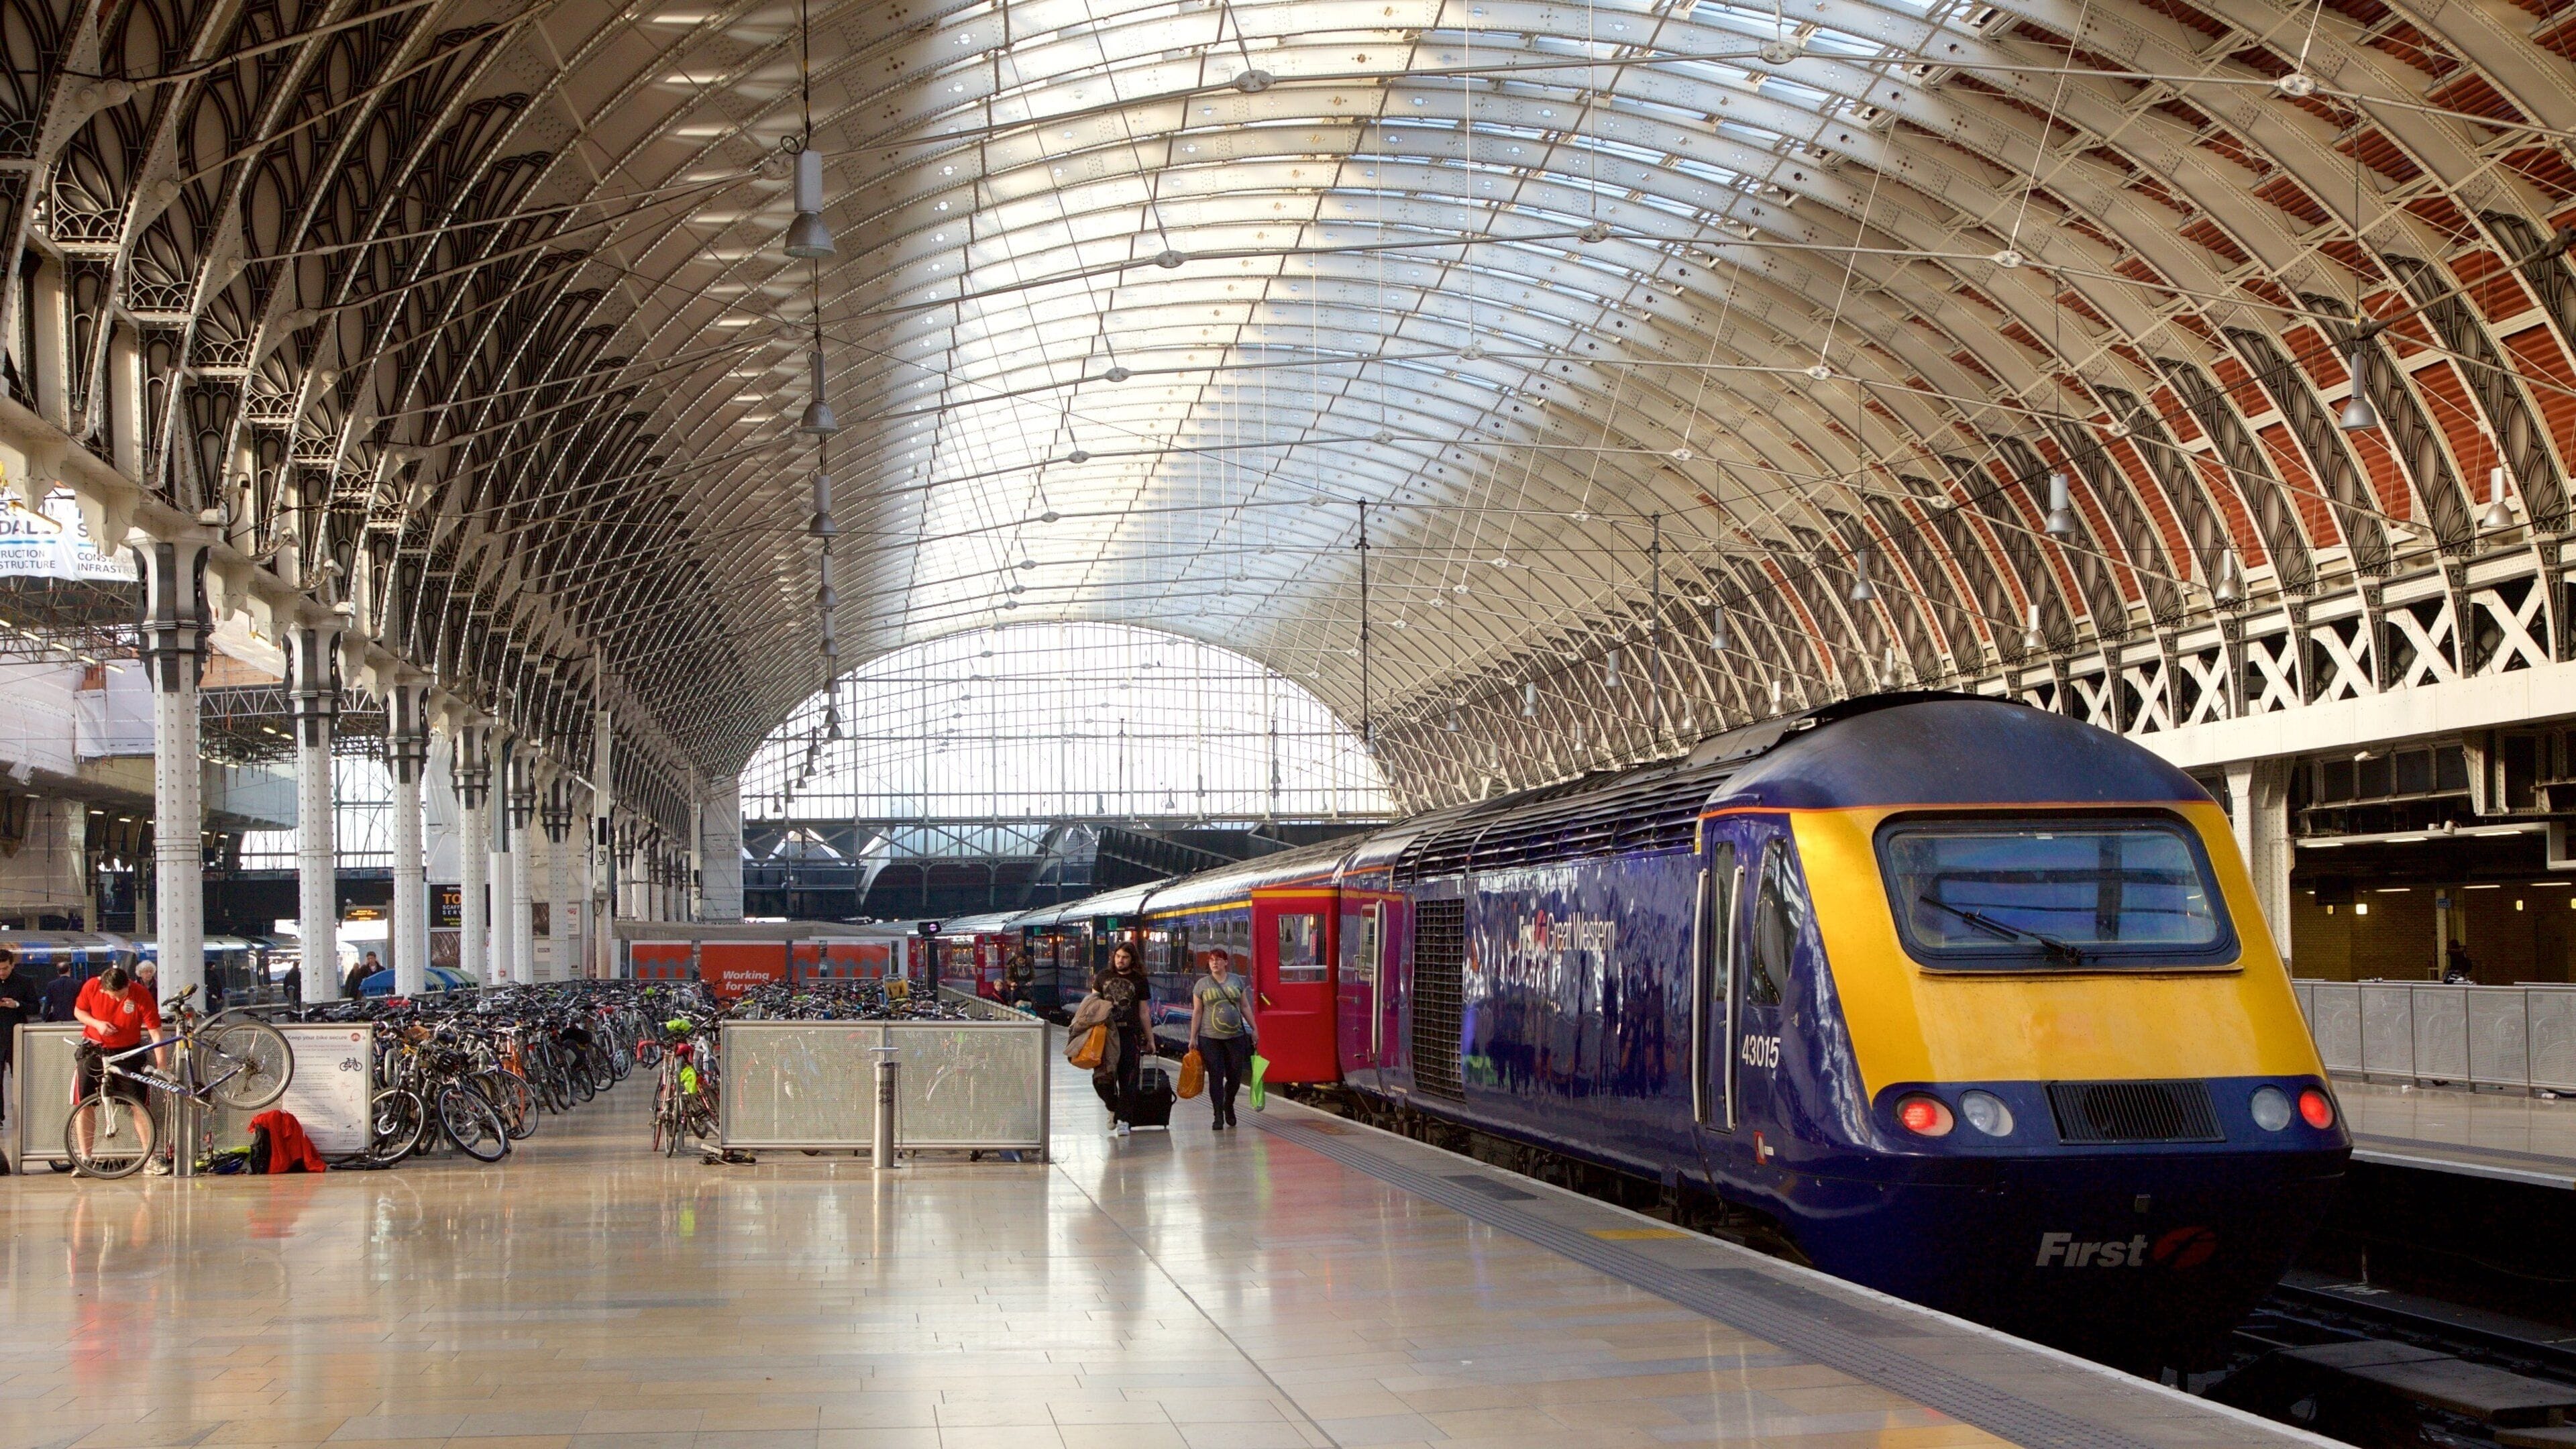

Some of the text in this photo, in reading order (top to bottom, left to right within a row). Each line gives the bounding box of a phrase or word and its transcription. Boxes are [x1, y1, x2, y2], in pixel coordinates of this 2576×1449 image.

[1519, 911, 1615, 951] First Great Western
[723, 970, 769, 980] Working
[726, 981, 743, 991] for
[1741, 1034, 1781, 1069] 43015
[2035, 1232, 2148, 1267] First
